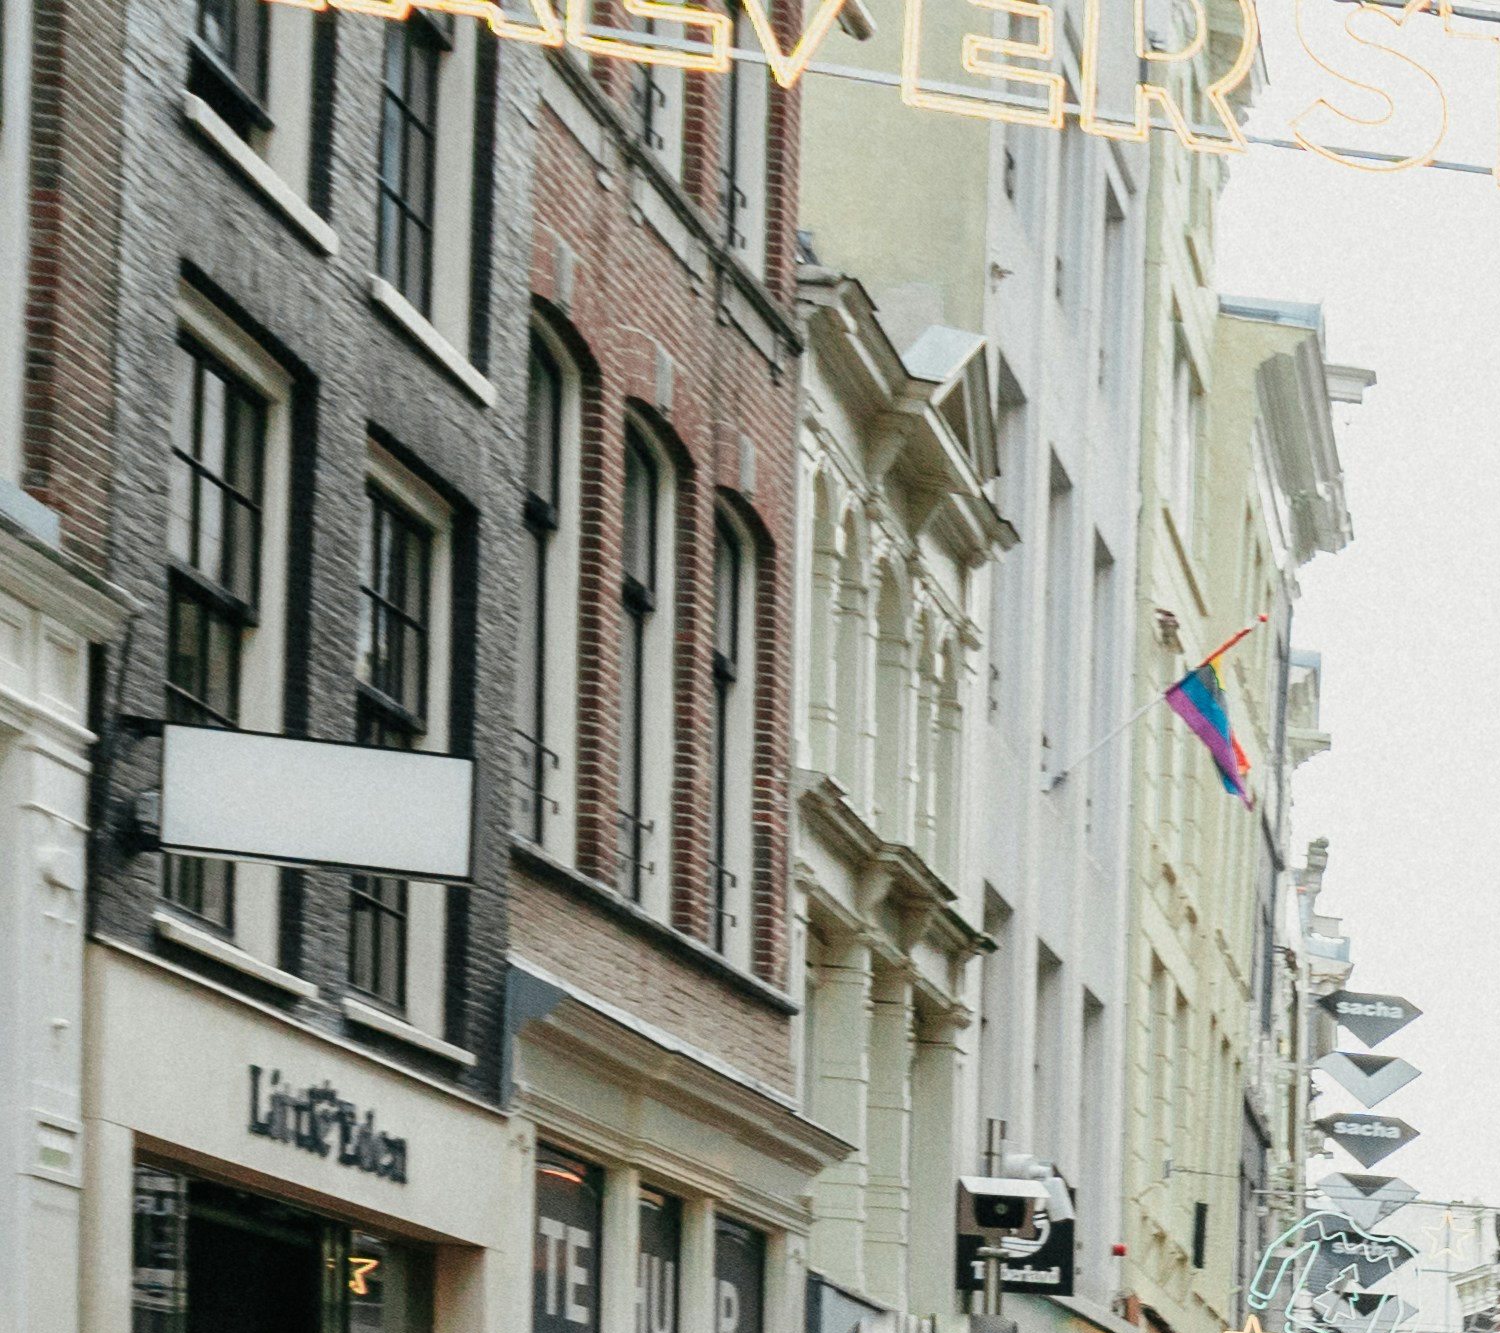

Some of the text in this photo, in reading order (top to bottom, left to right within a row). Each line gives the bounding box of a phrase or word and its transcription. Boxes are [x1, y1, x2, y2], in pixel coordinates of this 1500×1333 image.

[1336, 1001, 1404, 1019] sacha
[1333, 1121, 1401, 1139] sacha
[540, 1216, 592, 1325] TE
